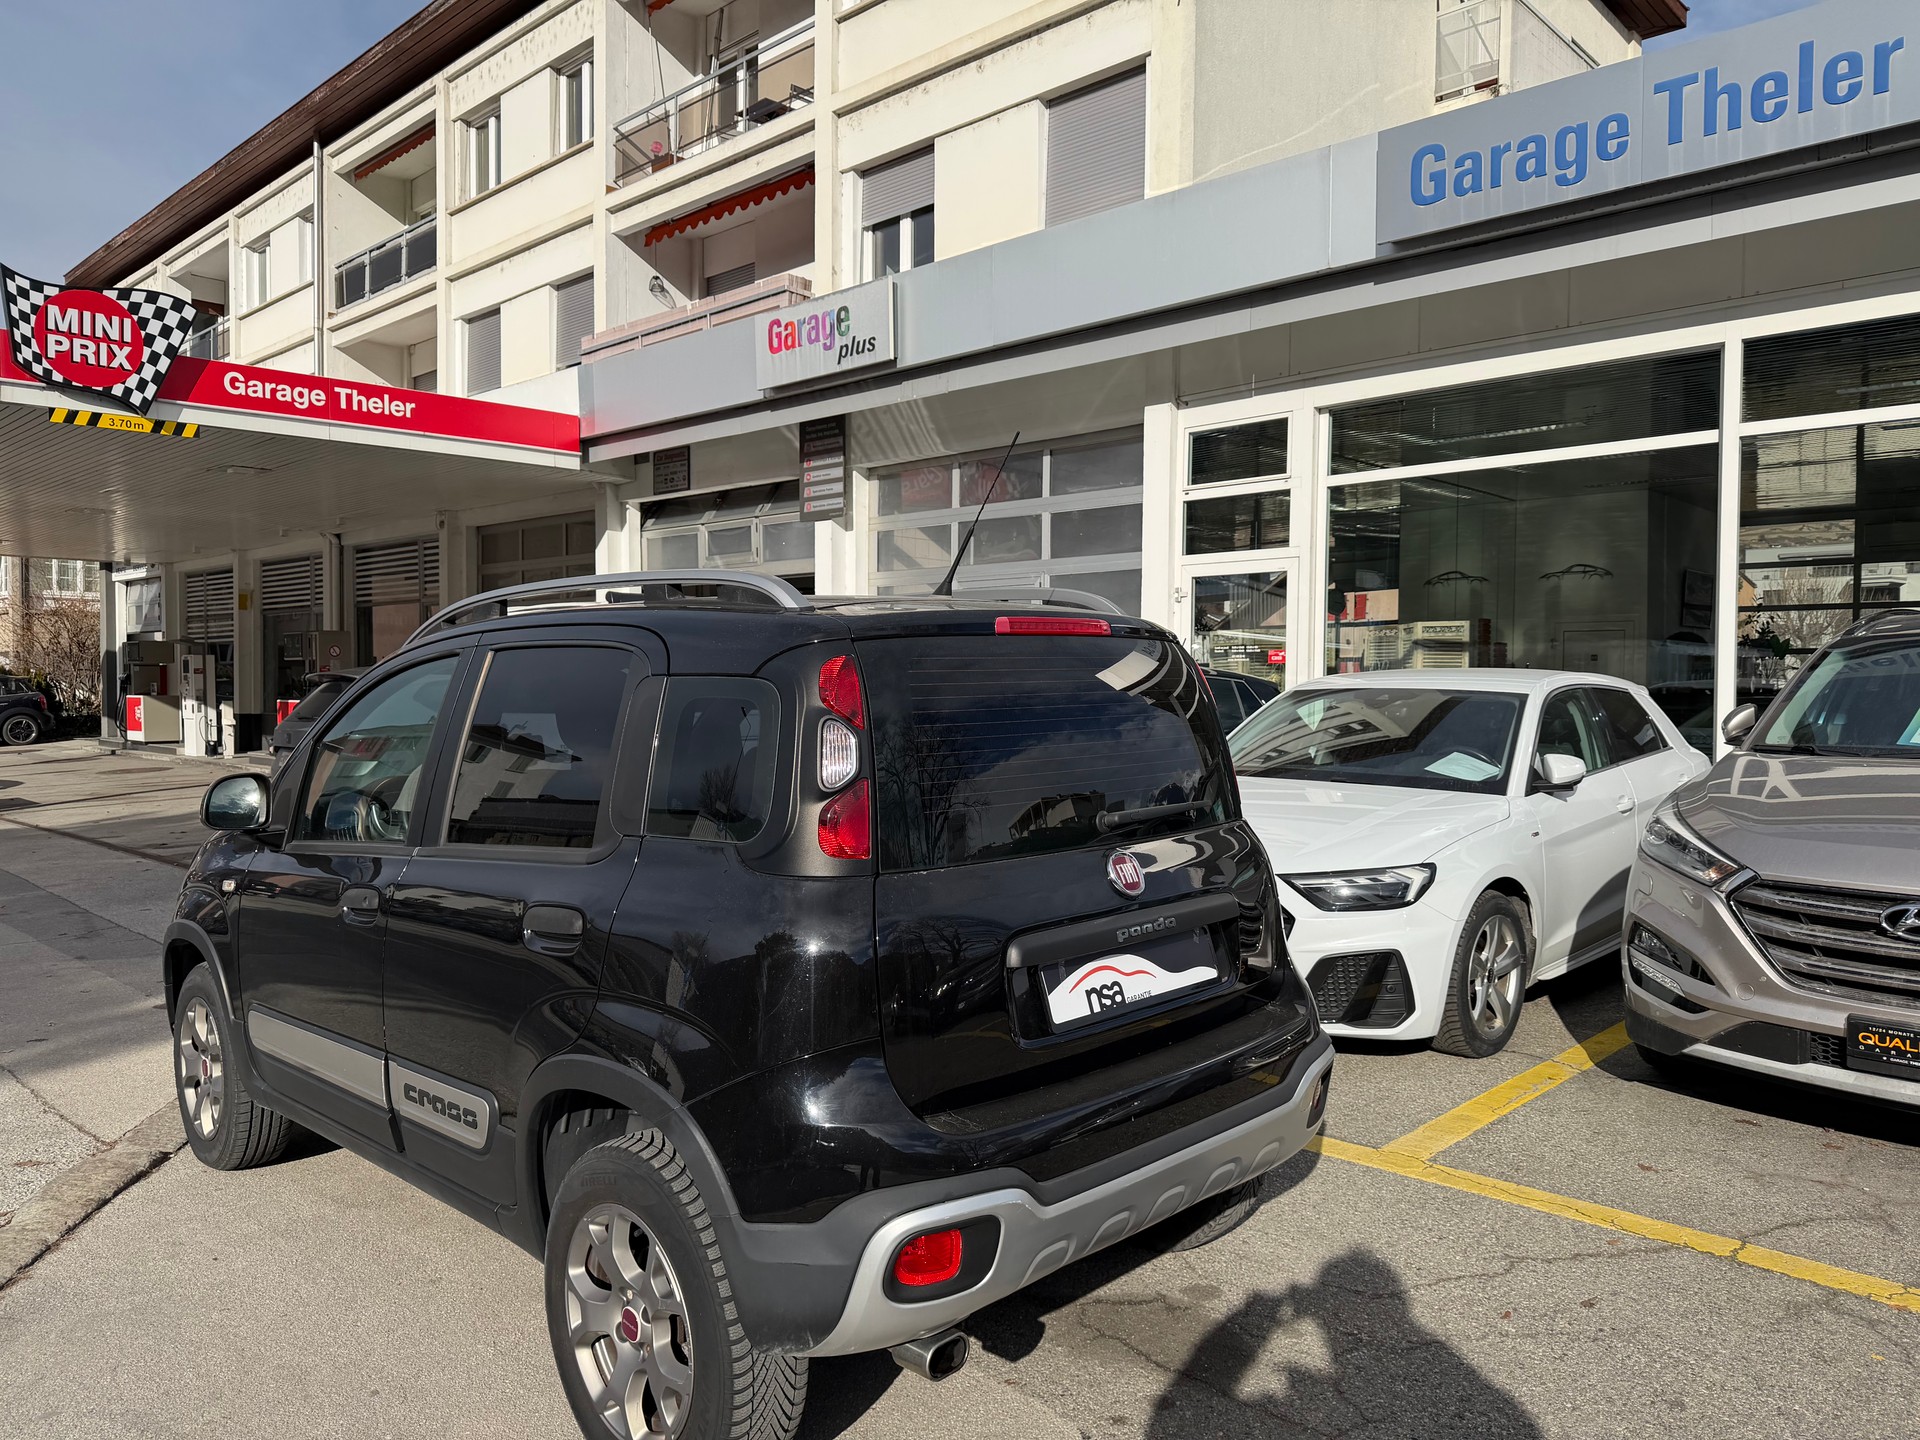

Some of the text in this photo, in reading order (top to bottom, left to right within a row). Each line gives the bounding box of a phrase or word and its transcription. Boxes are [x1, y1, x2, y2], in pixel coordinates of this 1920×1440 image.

[1409, 35, 1905, 207] Garage Theler
[46, 304, 132, 344] MINI
[767, 305, 850, 355] Garage
[46, 334, 133, 372] PRIX
[837, 335, 877, 365] plus
[223, 371, 416, 419] Garage Theler
[1115, 863, 1139, 884] FIAT
[1116, 917, 1177, 943] panda
[1084, 980, 1126, 1015] nsa
[1888, 1029, 1915, 1038] MONATE
[403, 1082, 478, 1130] cross
